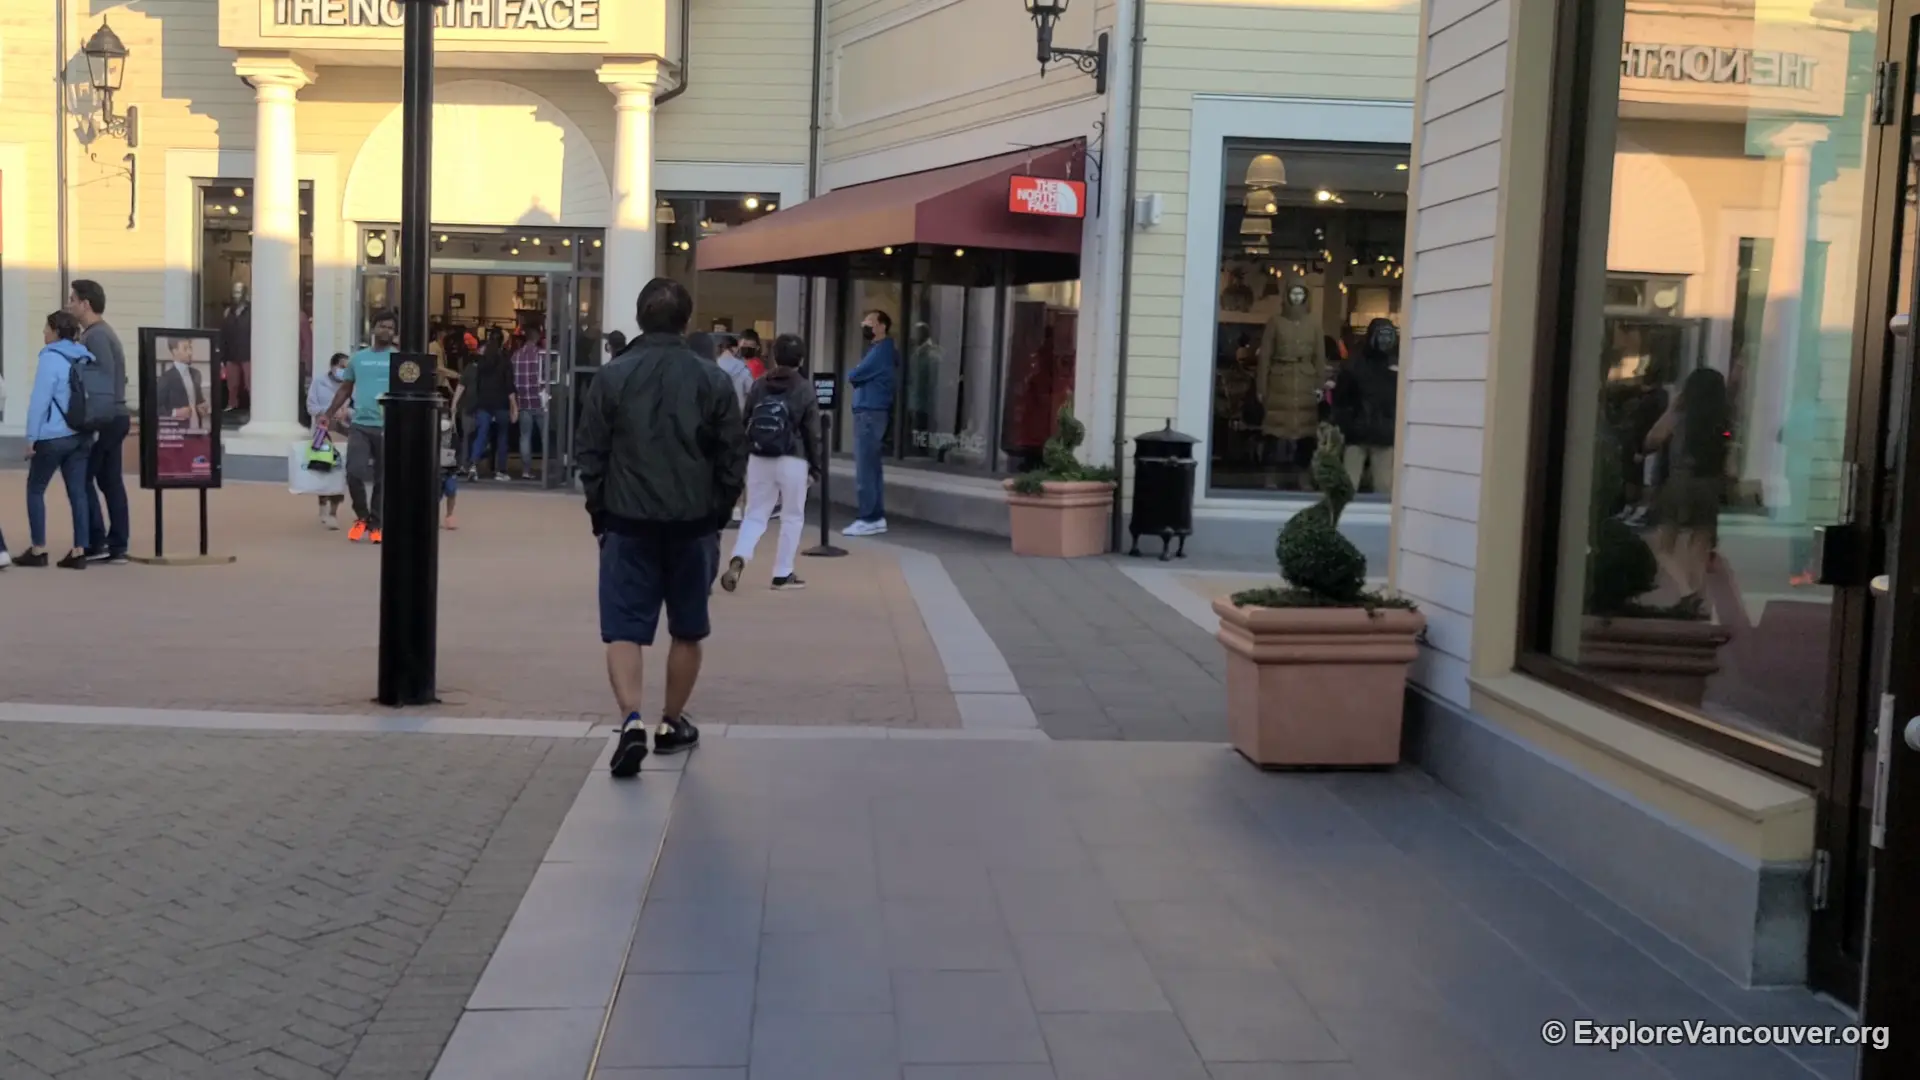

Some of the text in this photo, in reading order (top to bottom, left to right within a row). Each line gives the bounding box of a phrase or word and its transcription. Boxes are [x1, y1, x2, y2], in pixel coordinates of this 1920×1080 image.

[494, 0, 600, 30] FACE
[1035, 179, 1058, 192] THE
[1017, 188, 1058, 204] NORTH
[1028, 200, 1058, 213] FACE
